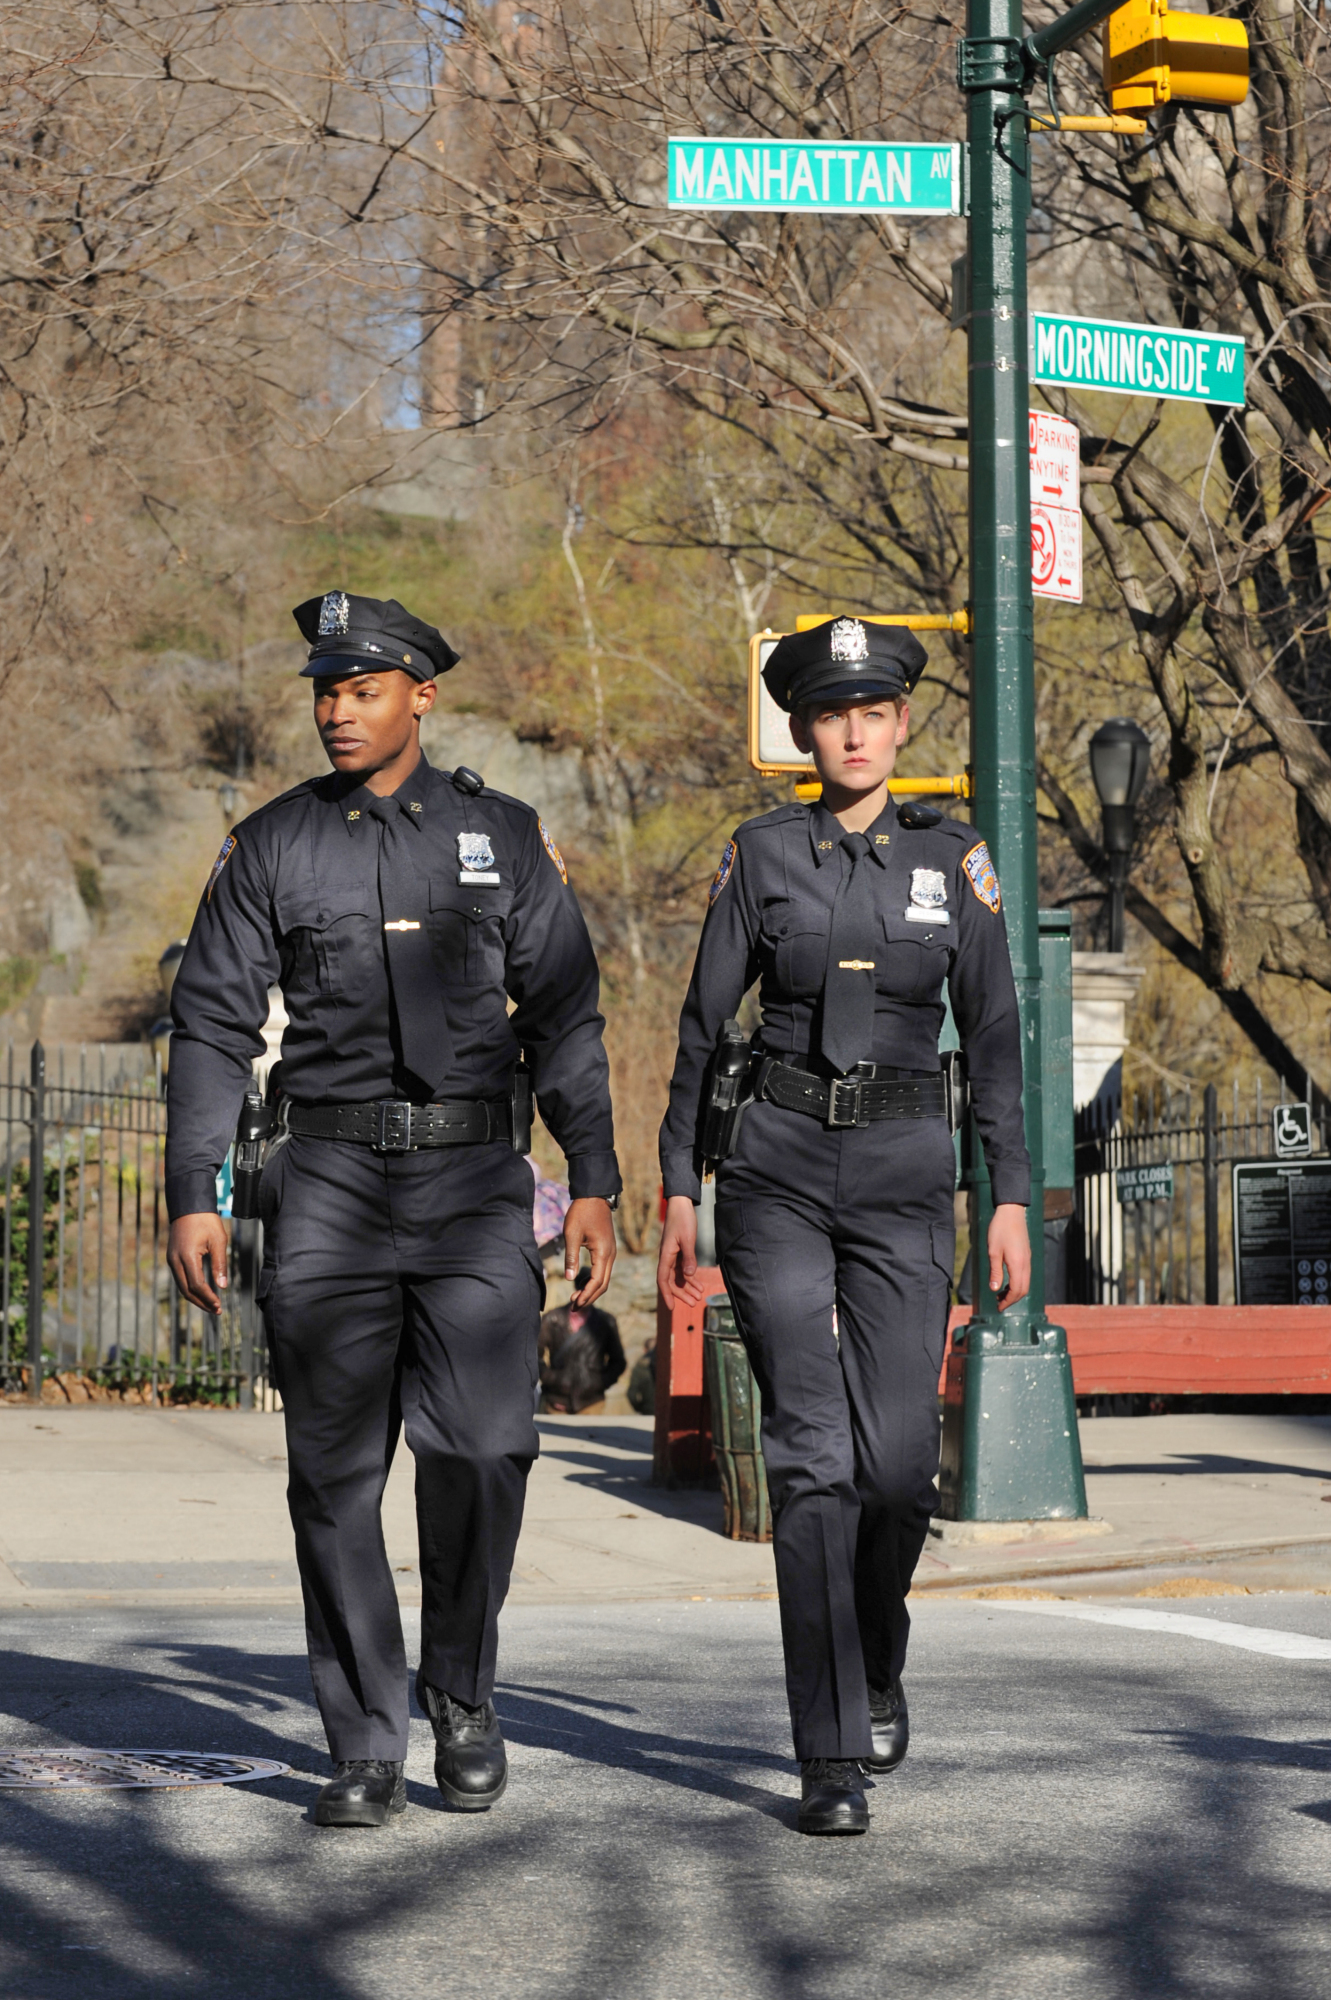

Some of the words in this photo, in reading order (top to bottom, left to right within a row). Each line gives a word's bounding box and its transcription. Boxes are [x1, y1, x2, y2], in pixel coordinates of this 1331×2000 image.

[675, 147, 912, 203] MANHATTAN
[930, 152, 951, 179] AV
[1037, 322, 1211, 395] MORNINGSIDE
[1216, 346, 1237, 374] AV
[1038, 427, 1076, 453] PARKING
[1029, 458, 1070, 483] ANYTIME
[347, 810, 360, 821] 22
[409, 801, 423, 813] 22
[875, 834, 890, 845] 22
[1117, 1170, 1137, 1186] PARK
[1138, 1166, 1173, 1184] CLOSES
[1124, 1186, 1133, 1201] AT
[1146, 1183, 1169, 1198] P.M.
